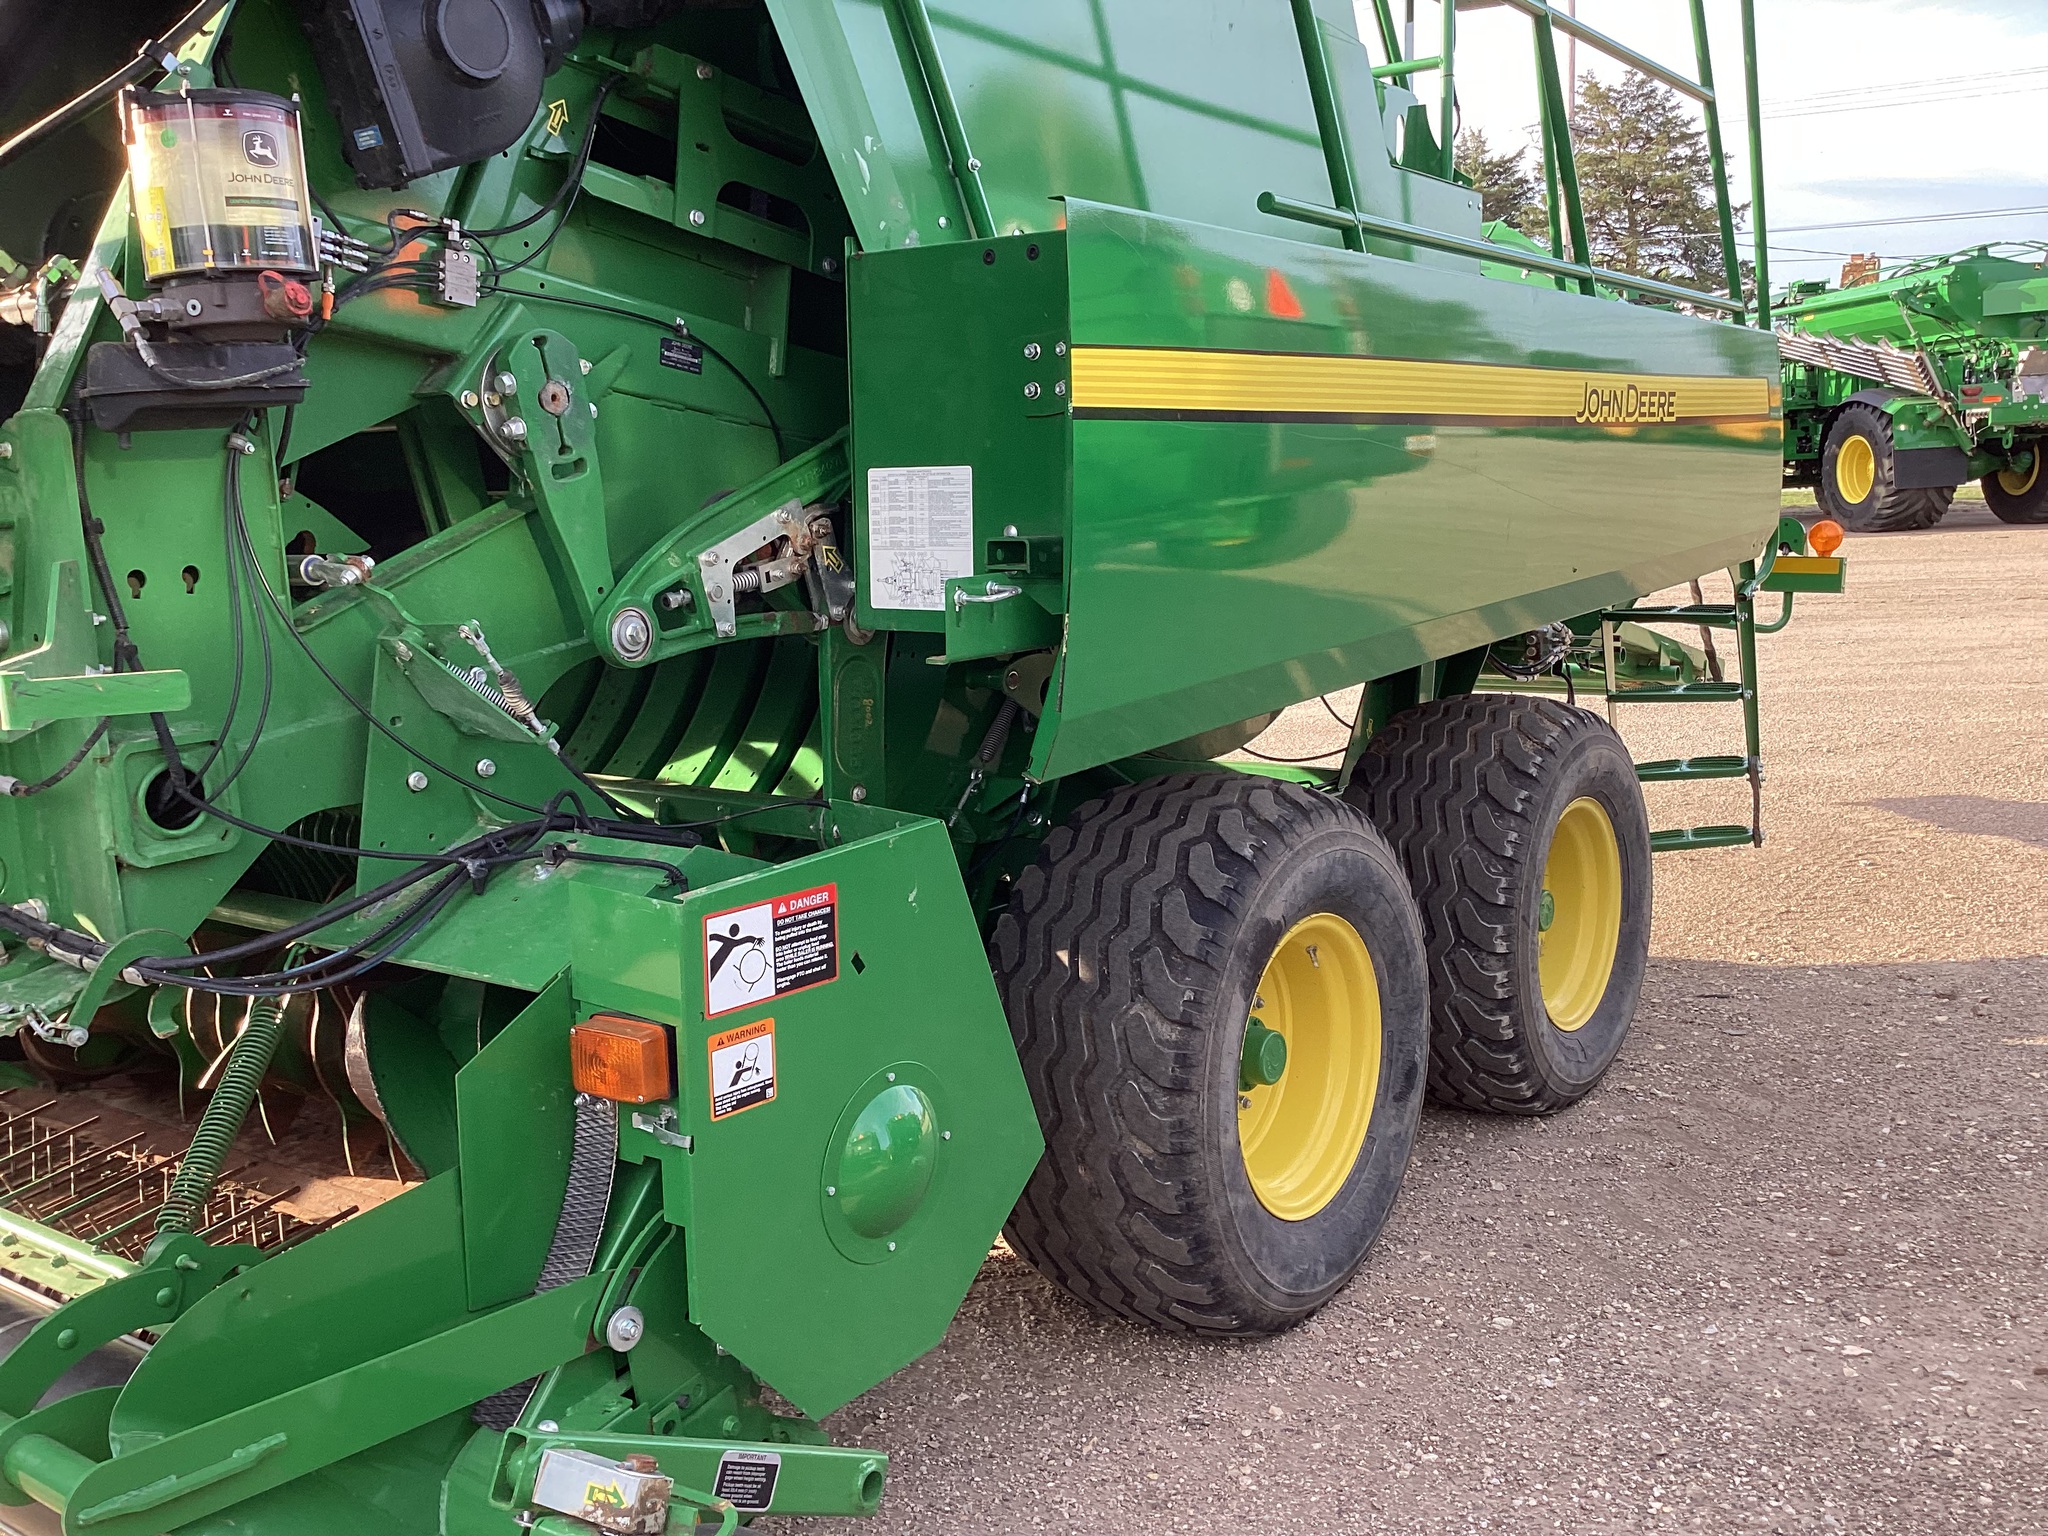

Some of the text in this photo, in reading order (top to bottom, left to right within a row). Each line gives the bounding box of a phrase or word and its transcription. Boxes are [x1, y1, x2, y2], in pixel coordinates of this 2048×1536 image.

[228, 172, 294, 187] JOHN DEERE
[1577, 381, 1676, 421] JOHN DEERE
[790, 892, 829, 910] DANGER
[726, 1023, 766, 1043] WARNING
[738, 1453, 767, 1461] IMPORTANT
